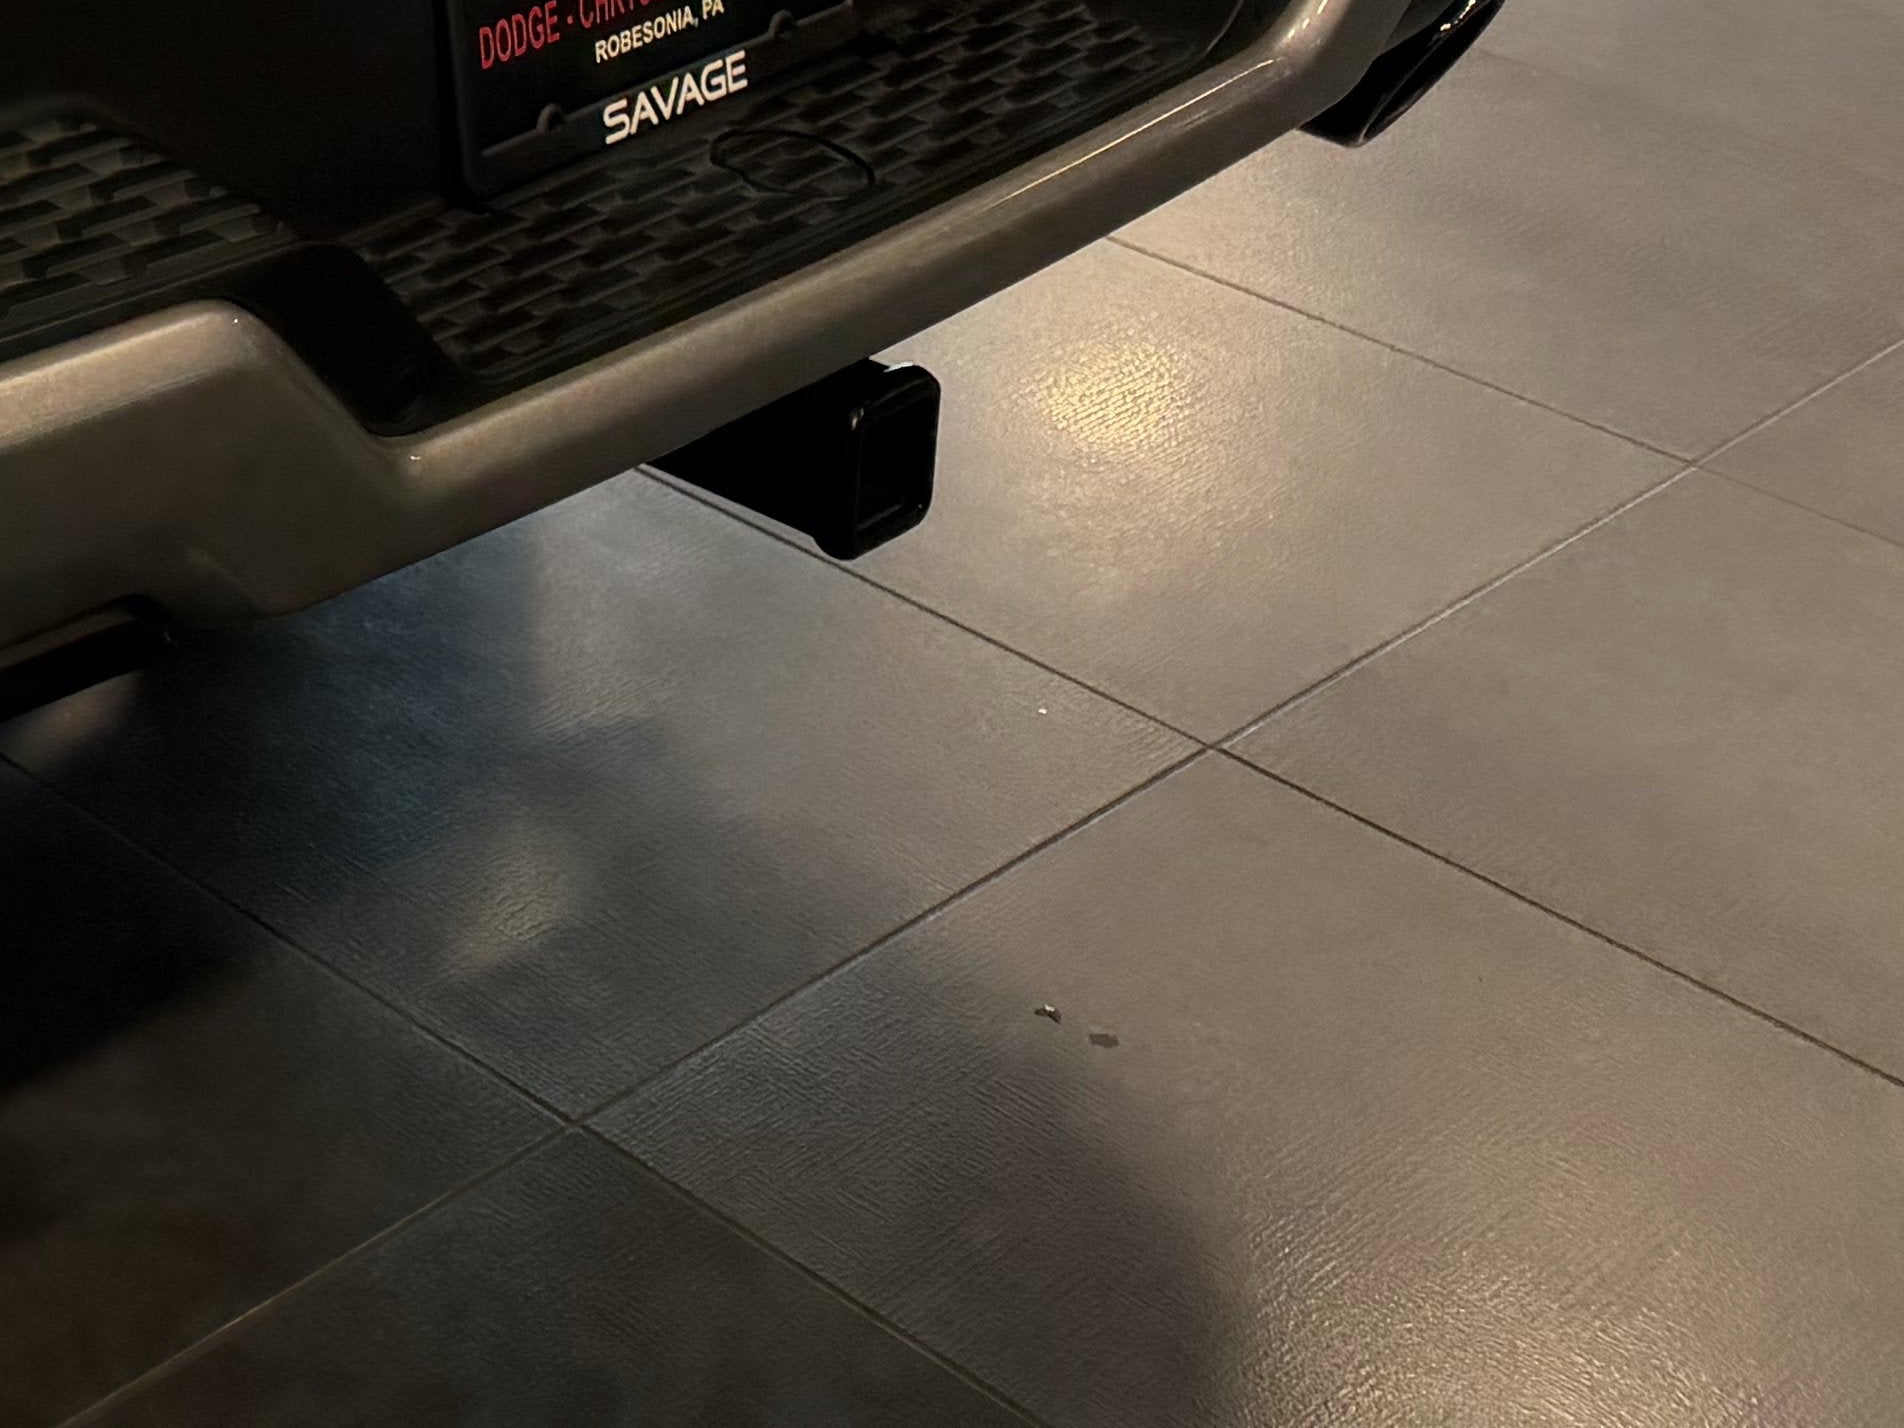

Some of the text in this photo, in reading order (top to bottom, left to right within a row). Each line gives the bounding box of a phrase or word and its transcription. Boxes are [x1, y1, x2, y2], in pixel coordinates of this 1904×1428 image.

[479, 0, 560, 69] DODGE
[594, 5, 699, 64] ROBESONIA,
[602, 49, 748, 145] SAVAGE
